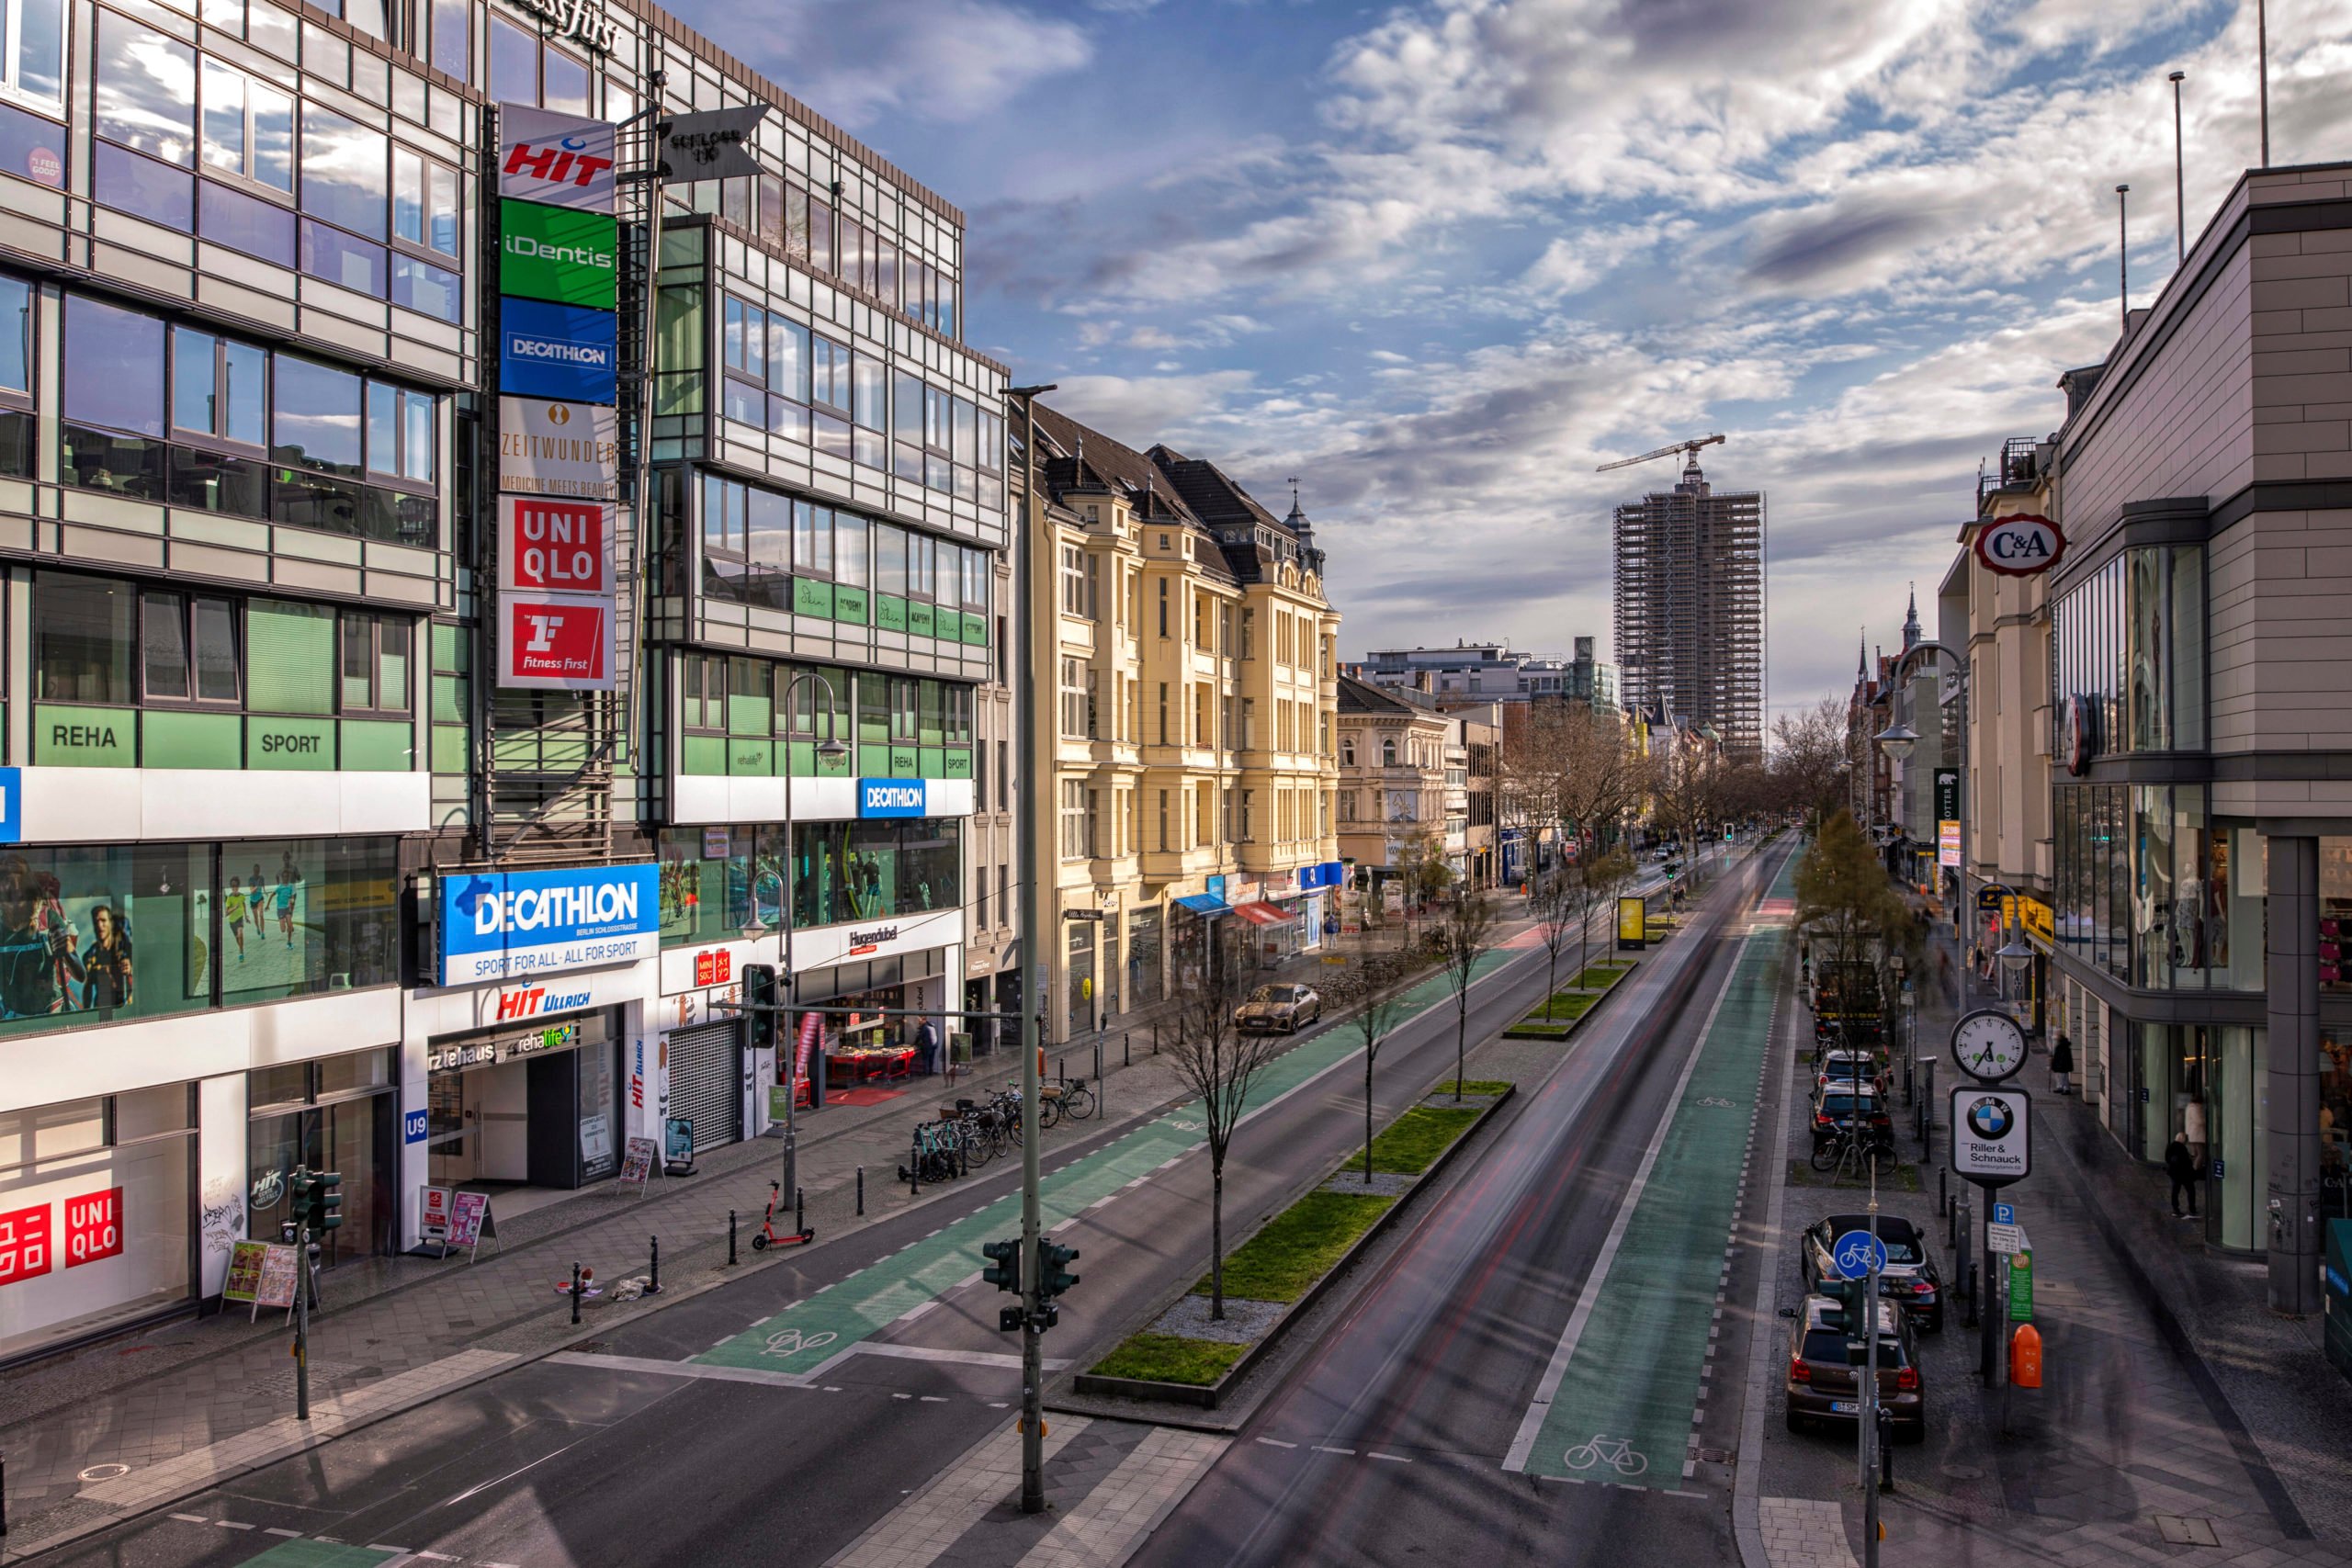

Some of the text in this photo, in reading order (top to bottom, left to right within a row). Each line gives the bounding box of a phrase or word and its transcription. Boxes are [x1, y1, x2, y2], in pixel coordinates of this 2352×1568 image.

[40, 159, 60, 169] FEEL
[503, 139, 613, 186] HIT
[505, 234, 612, 268] iDentis
[514, 339, 605, 364] DECATHLON
[502, 434, 615, 464] ZEITWUNDER
[502, 475, 615, 497] MEDICINE MEETS BEAUTY
[524, 511, 586, 544] UNI
[1993, 530, 2050, 558] C&A
[524, 547, 593, 582] QLO
[524, 656, 588, 670] Fitness First
[52, 725, 118, 749] REHA
[262, 734, 321, 754] SPORT
[894, 756, 913, 768] REHA
[947, 759, 967, 770] SPORT
[866, 787, 922, 808] DECATHLON
[475, 882, 639, 935] DECATHLON
[576, 927, 594, 937] BERLIN
[850, 926, 897, 948] Hugendubel
[475, 957, 512, 976] SPORT
[514, 954, 536, 971] FOR
[538, 952, 558, 967] ALL
[564, 948, 583, 964] ALL
[585, 946, 605, 961] FOR
[606, 941, 638, 958] SPORT
[496, 982, 545, 1021] HIT
[518, 1030, 563, 1052] rehalife
[631, 1074, 643, 1110] HIT
[1972, 1097, 2010, 1112] BMW
[407, 1116, 426, 1136] U9
[1970, 1153, 2021, 1164] Schnauck
[1971, 1143, 2006, 1153] Riller &
[252, 1170, 281, 1195] HIT
[72, 1198, 112, 1229] UNI
[1998, 1206, 2010, 1222] P
[72, 1225, 117, 1259] QLO
